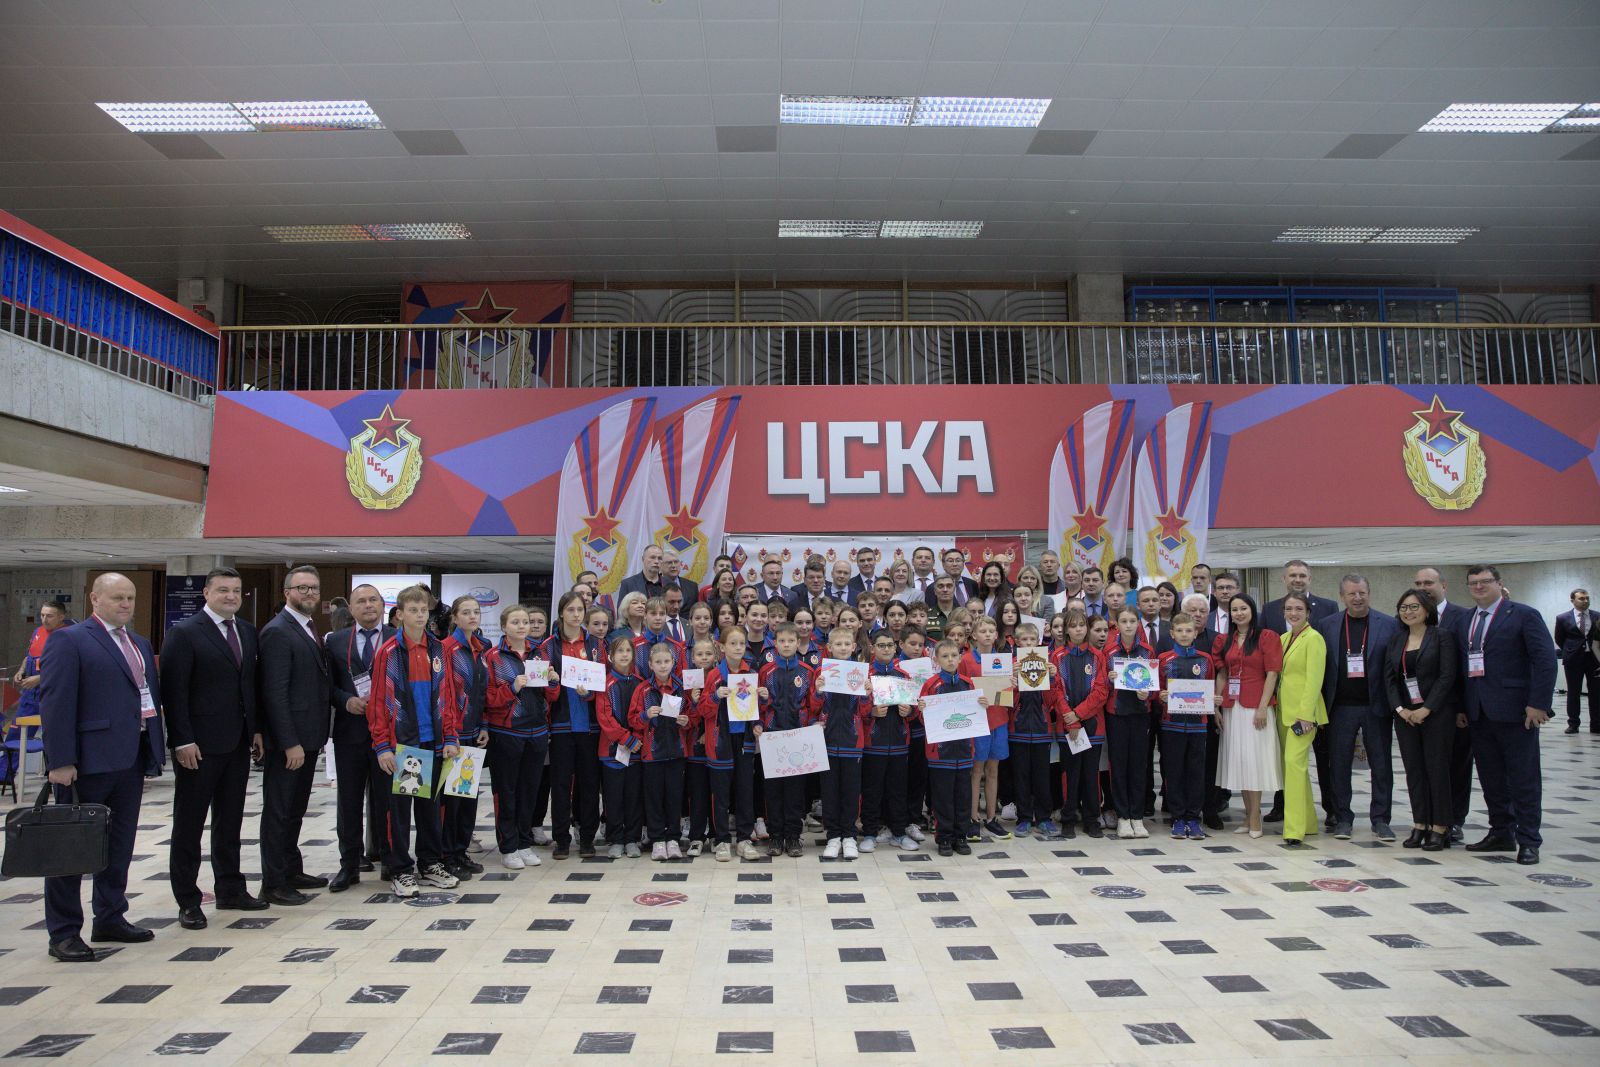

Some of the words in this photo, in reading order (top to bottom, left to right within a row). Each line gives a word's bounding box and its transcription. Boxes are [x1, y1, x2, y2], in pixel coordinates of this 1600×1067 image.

[367, 457, 394, 483] ЦСКА
[767, 421, 994, 504] ЦСКА
[1425, 452, 1459, 481] ЦСКА
[584, 551, 609, 572] ЦСКА
[1075, 549, 1098, 568] ЦСКА
[1158, 549, 1180, 569] ЦСКА
[1021, 660, 1046, 672] ЦСКА
